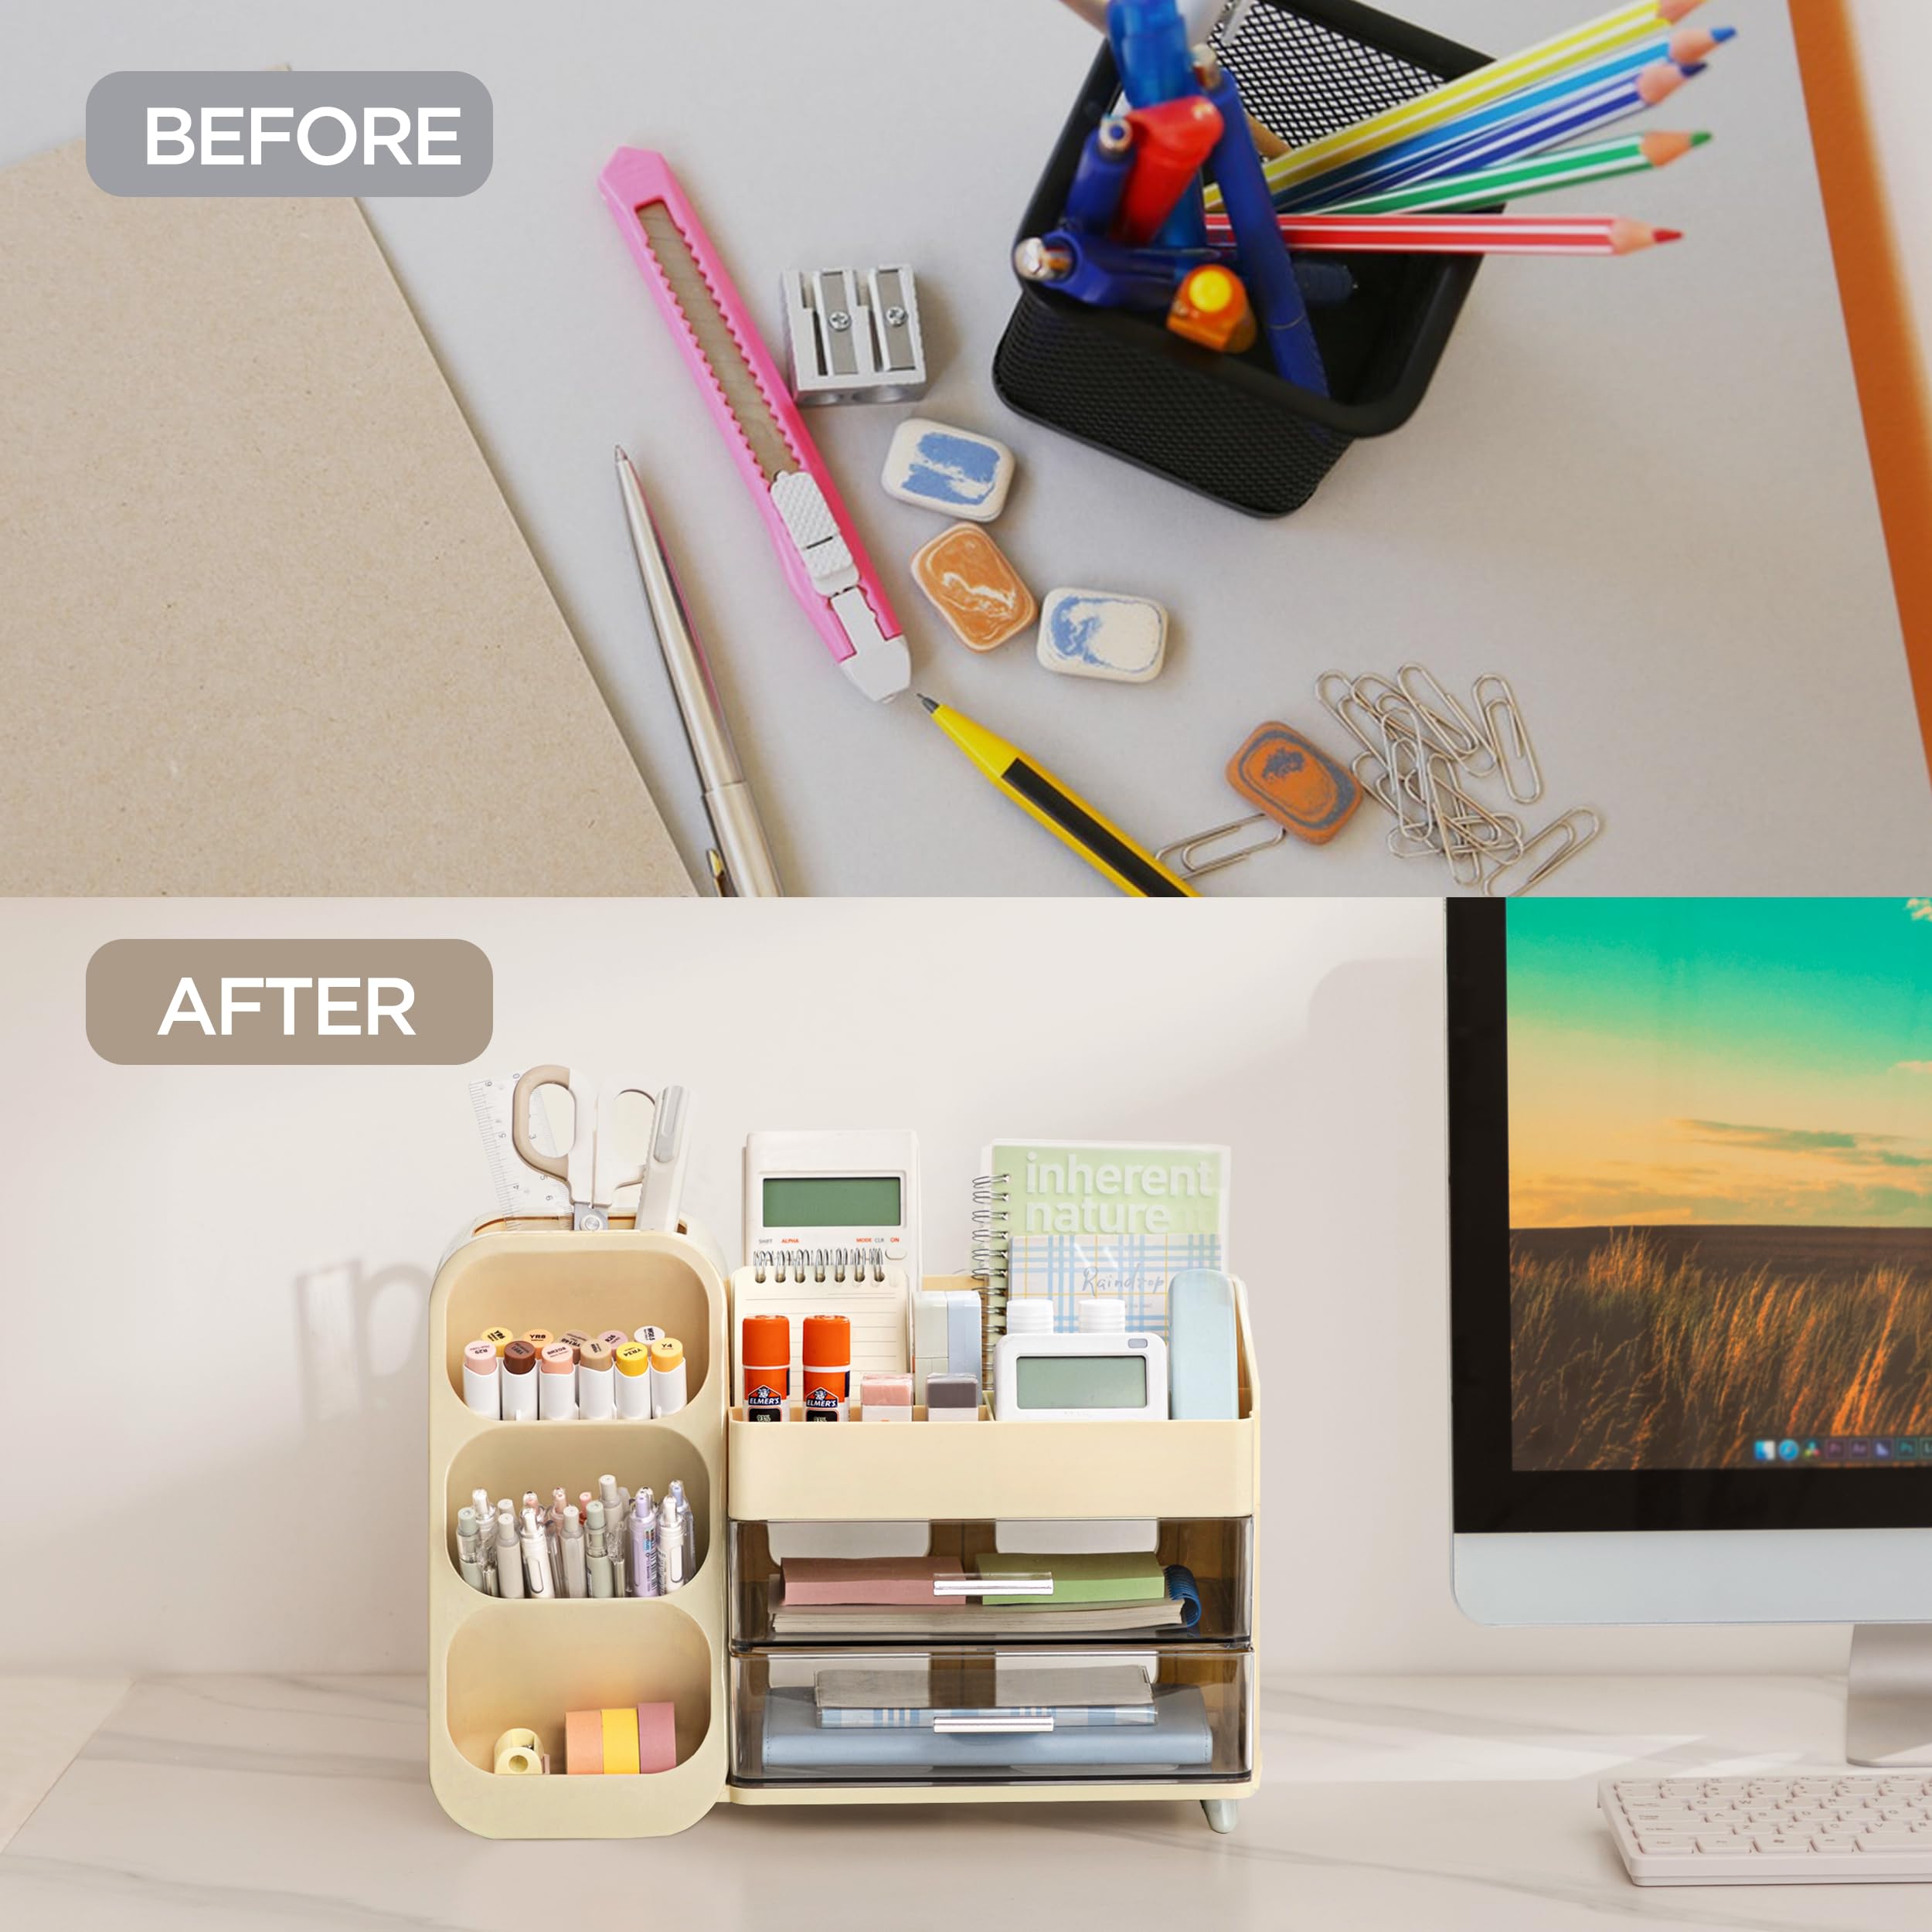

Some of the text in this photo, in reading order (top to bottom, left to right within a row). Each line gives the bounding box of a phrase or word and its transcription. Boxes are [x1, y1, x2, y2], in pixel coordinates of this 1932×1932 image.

[1026, 1151, 1213, 1197] inherent
[1026, 1196, 1171, 1233] nature
[1082, 1264, 1164, 1298] Raindrop
